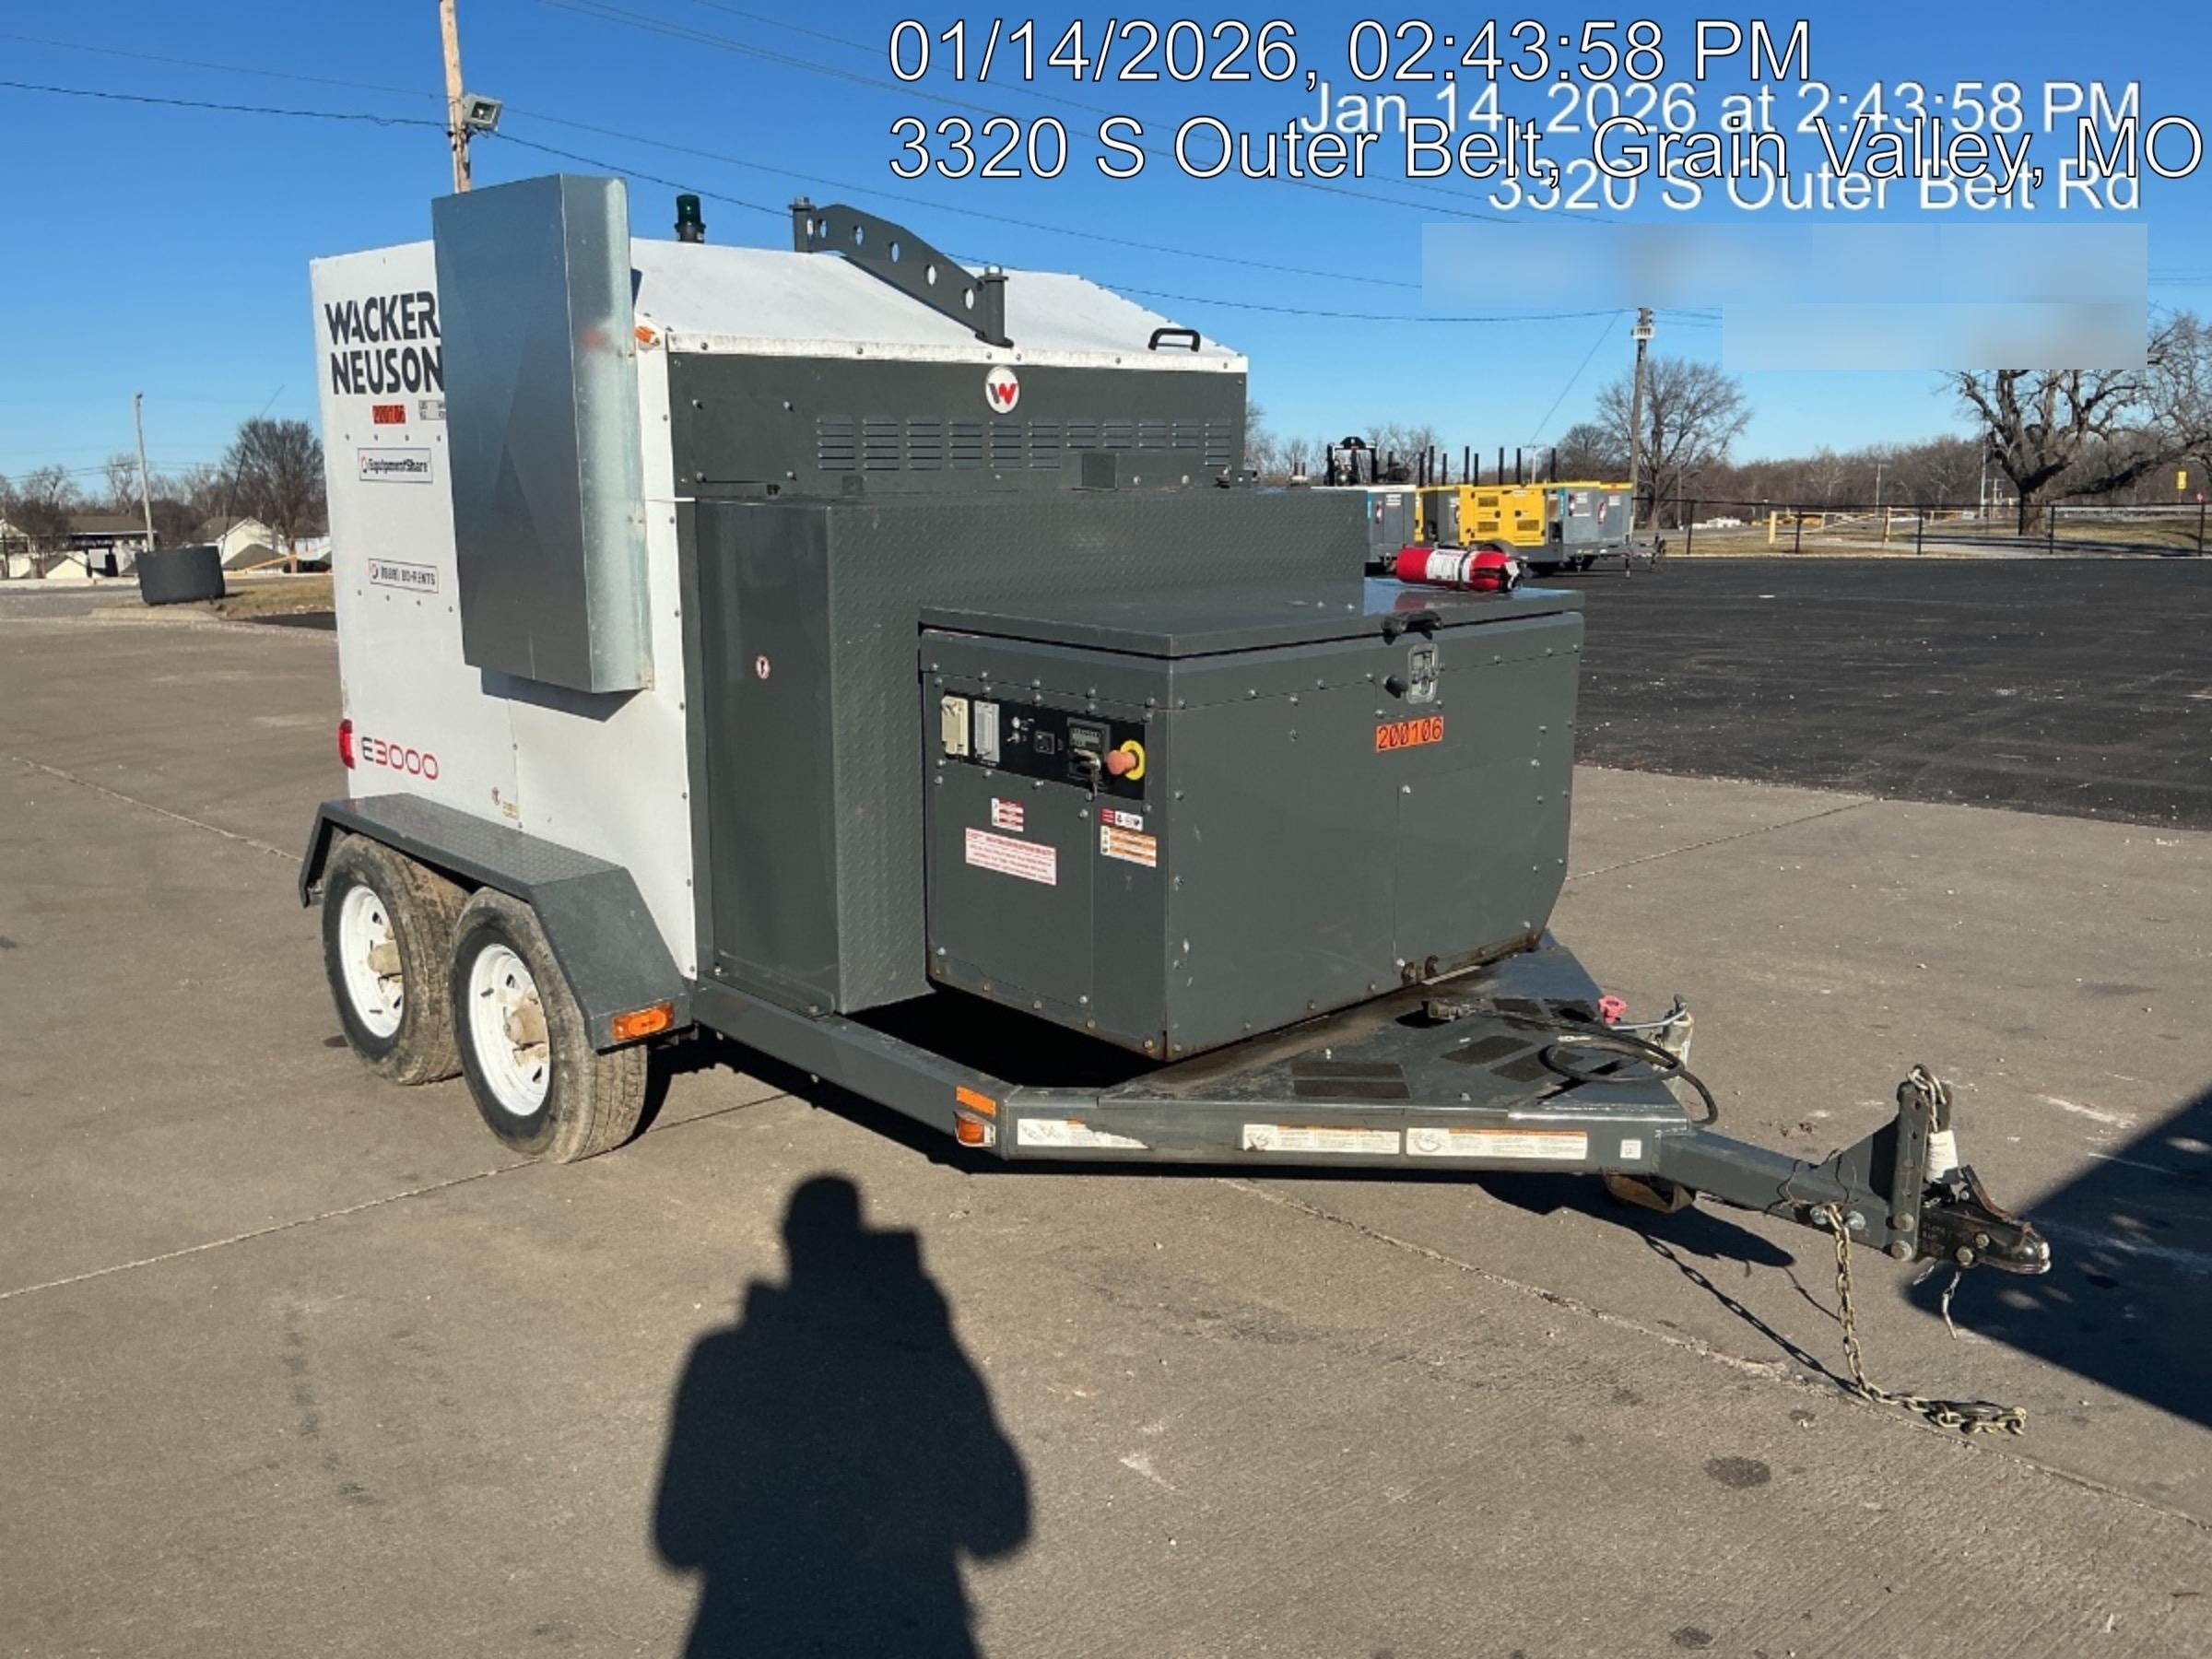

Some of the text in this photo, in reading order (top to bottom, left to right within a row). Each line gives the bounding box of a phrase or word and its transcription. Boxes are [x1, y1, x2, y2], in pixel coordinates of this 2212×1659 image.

[324, 290, 441, 346] WACKER
[330, 345, 446, 395] NEUSON
[1377, 717, 1443, 749] 200106
[360, 736, 440, 781] E3000
